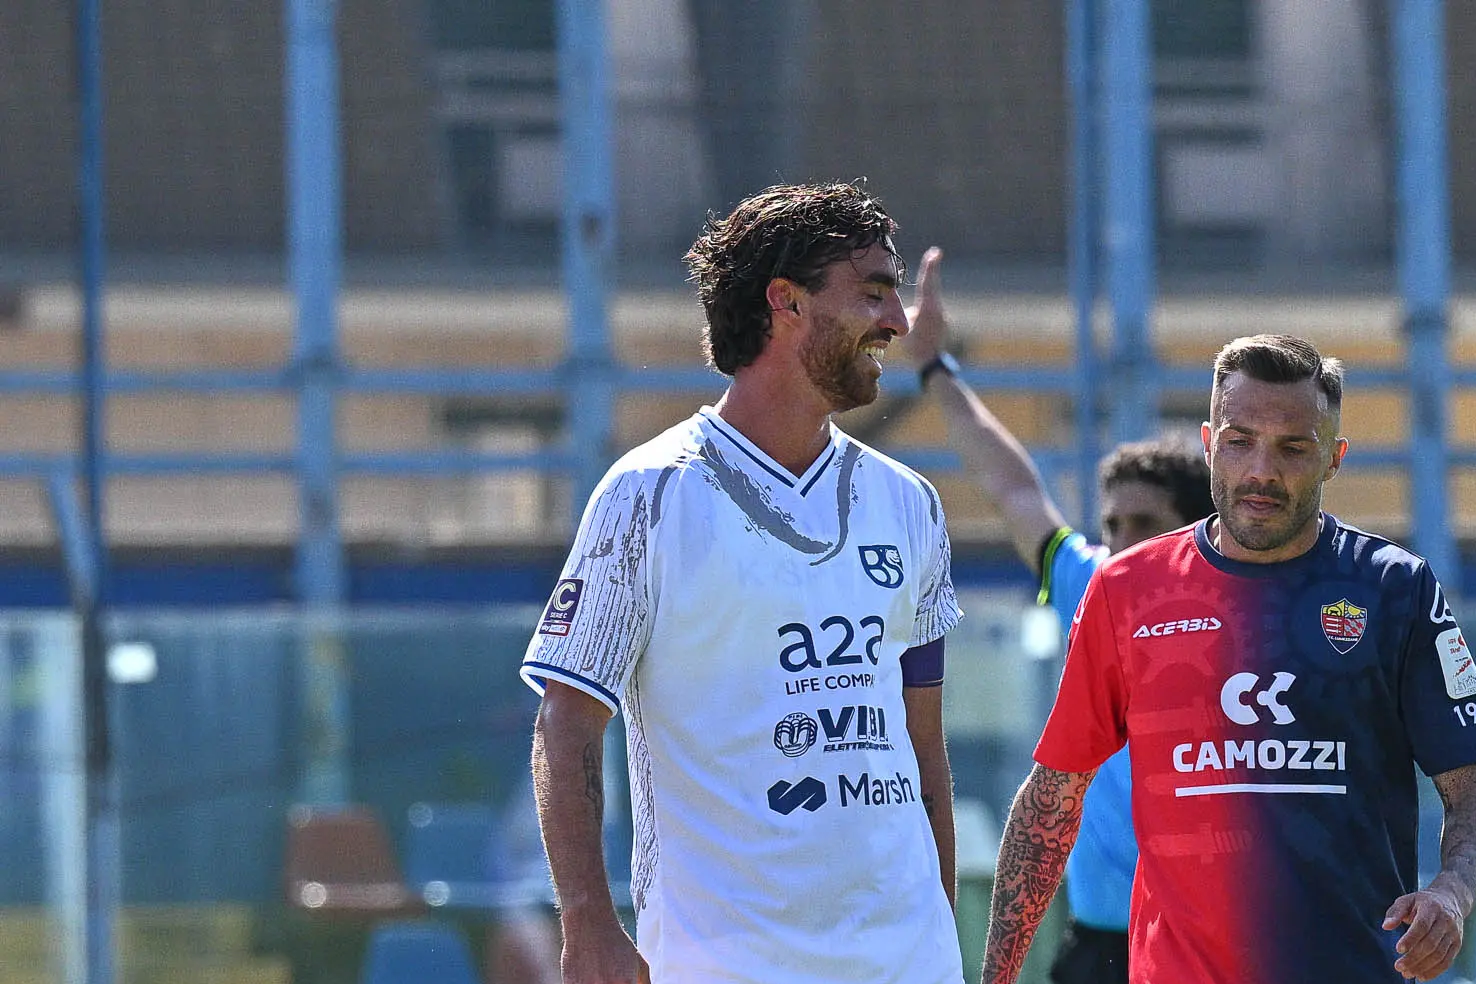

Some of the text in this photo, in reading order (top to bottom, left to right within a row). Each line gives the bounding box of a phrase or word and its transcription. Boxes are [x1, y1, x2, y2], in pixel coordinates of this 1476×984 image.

[785, 678, 820, 696] LIFE
[1172, 739, 1346, 773] CAMOZZI
[838, 772, 915, 807] Marsh
